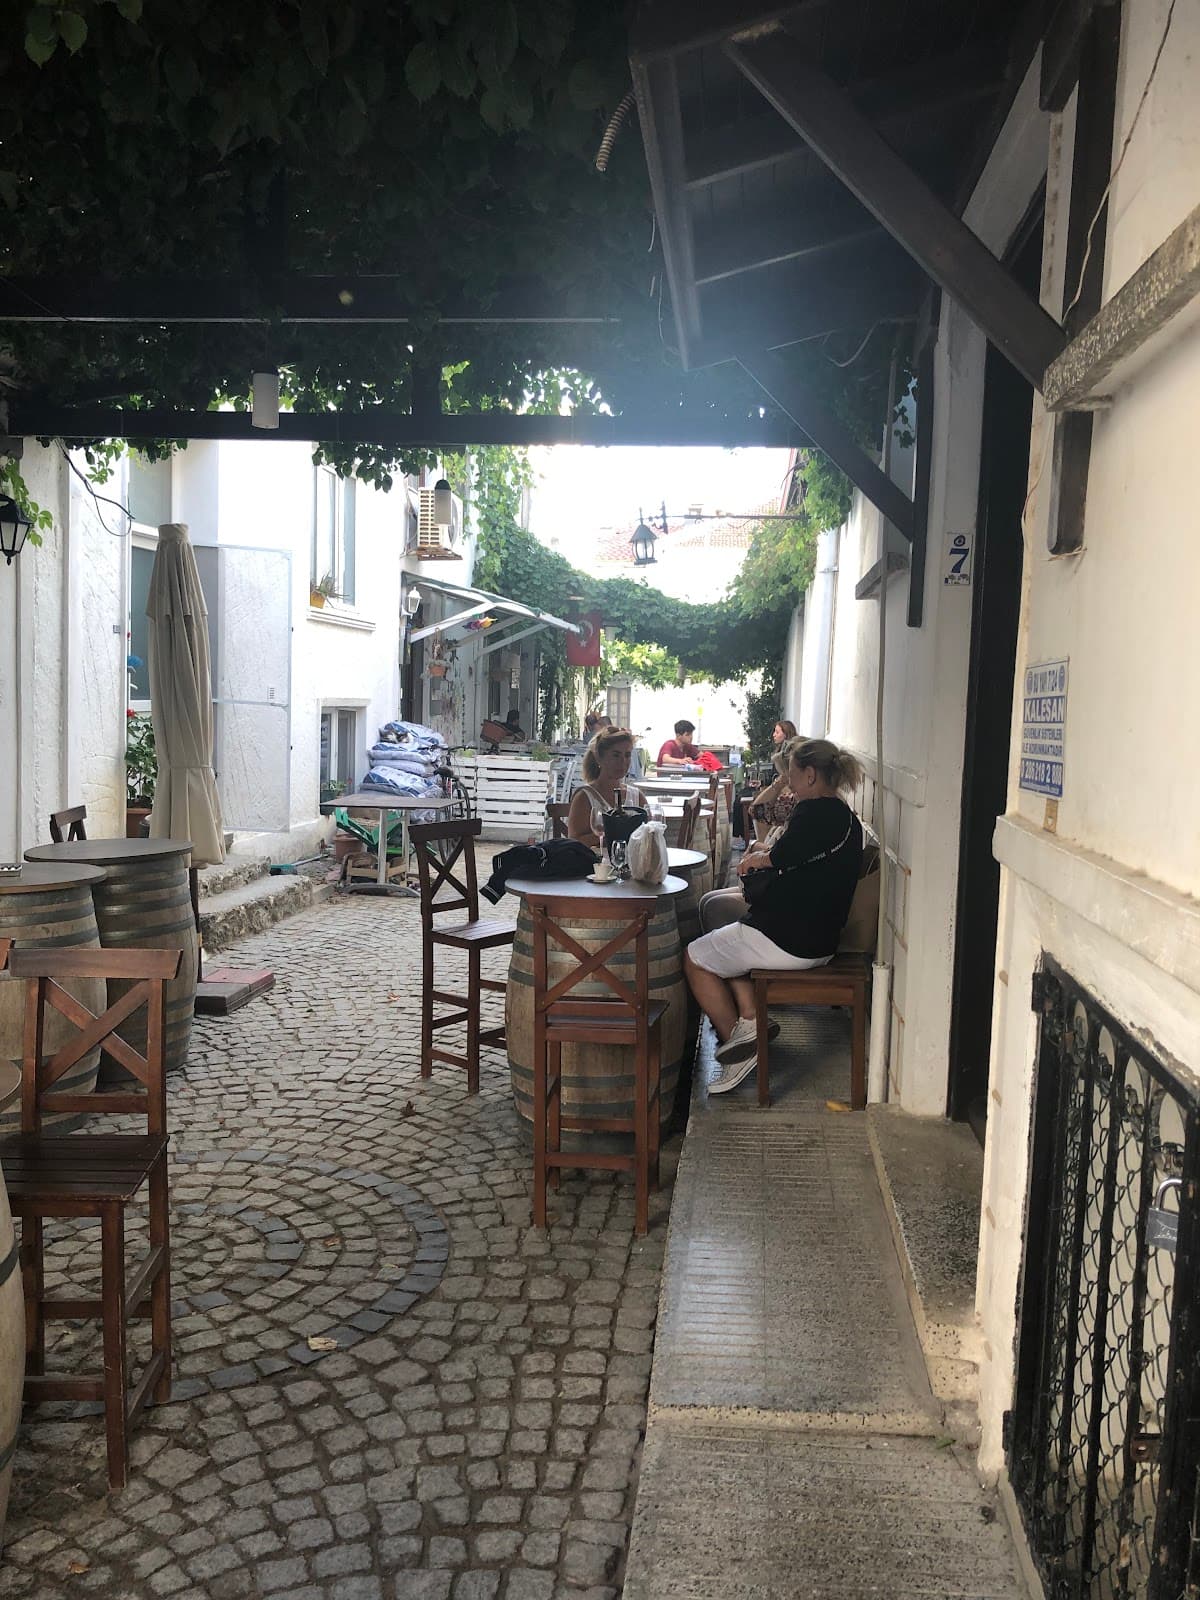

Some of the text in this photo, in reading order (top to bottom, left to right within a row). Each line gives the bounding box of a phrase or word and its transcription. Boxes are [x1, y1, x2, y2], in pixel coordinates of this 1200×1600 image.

[949, 548, 970, 573] 7
[1025, 698, 1065, 721] KALESAN
[1045, 763, 1051, 784] 2
